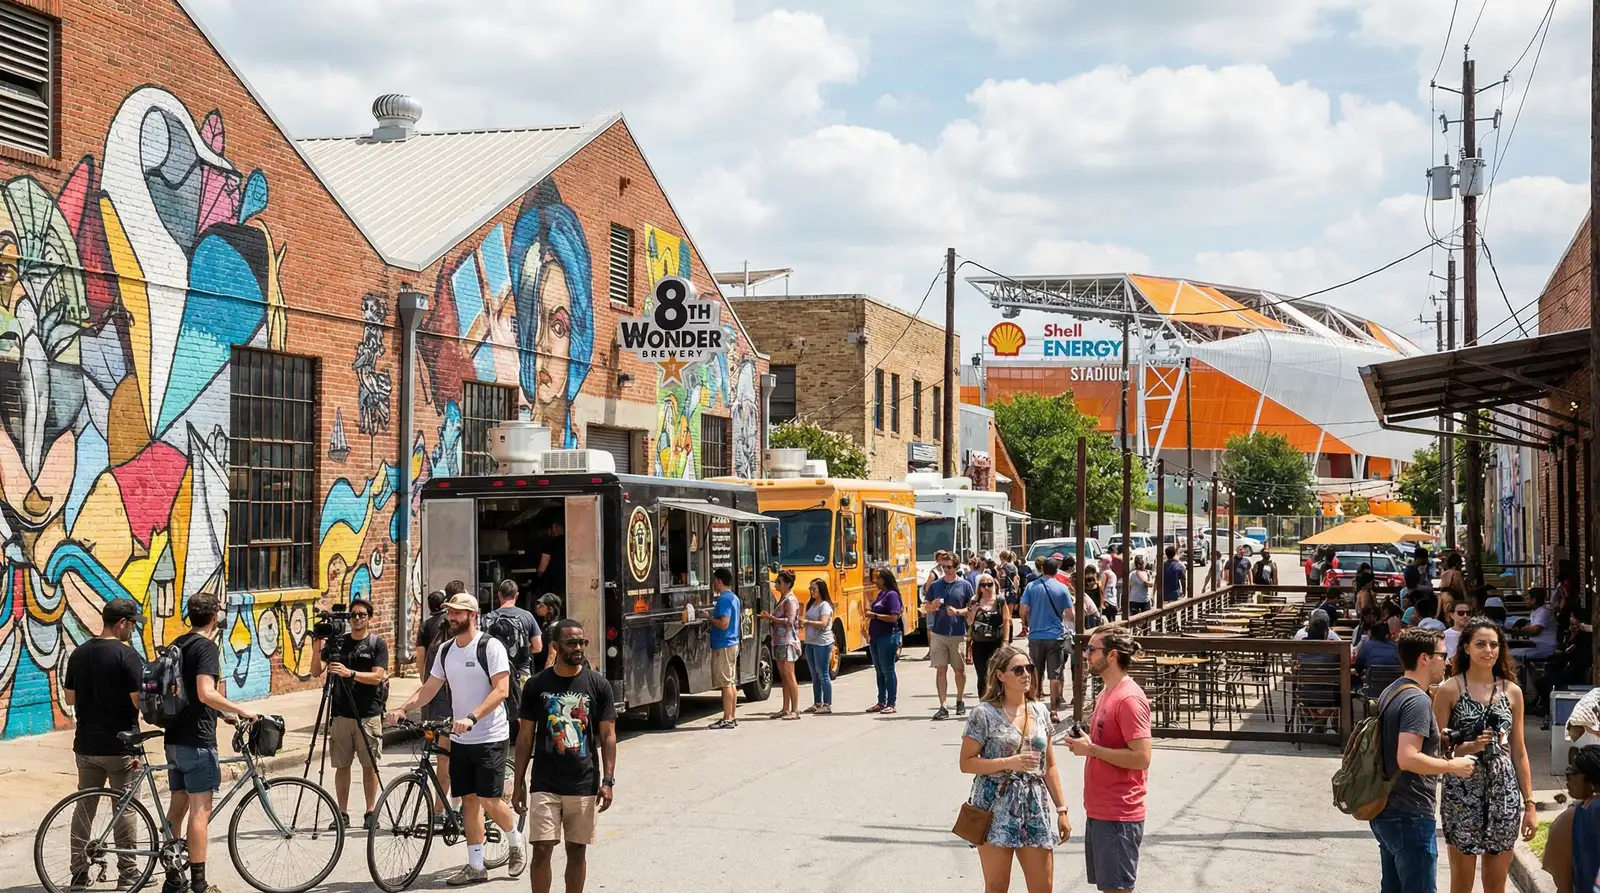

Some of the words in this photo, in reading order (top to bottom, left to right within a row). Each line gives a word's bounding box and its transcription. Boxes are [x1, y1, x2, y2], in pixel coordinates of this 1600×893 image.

[655, 280, 710, 330] 8TH
[621, 322, 721, 348] WONDER
[1044, 323, 1082, 337] Shell
[1044, 340, 1123, 357] ENERGY
